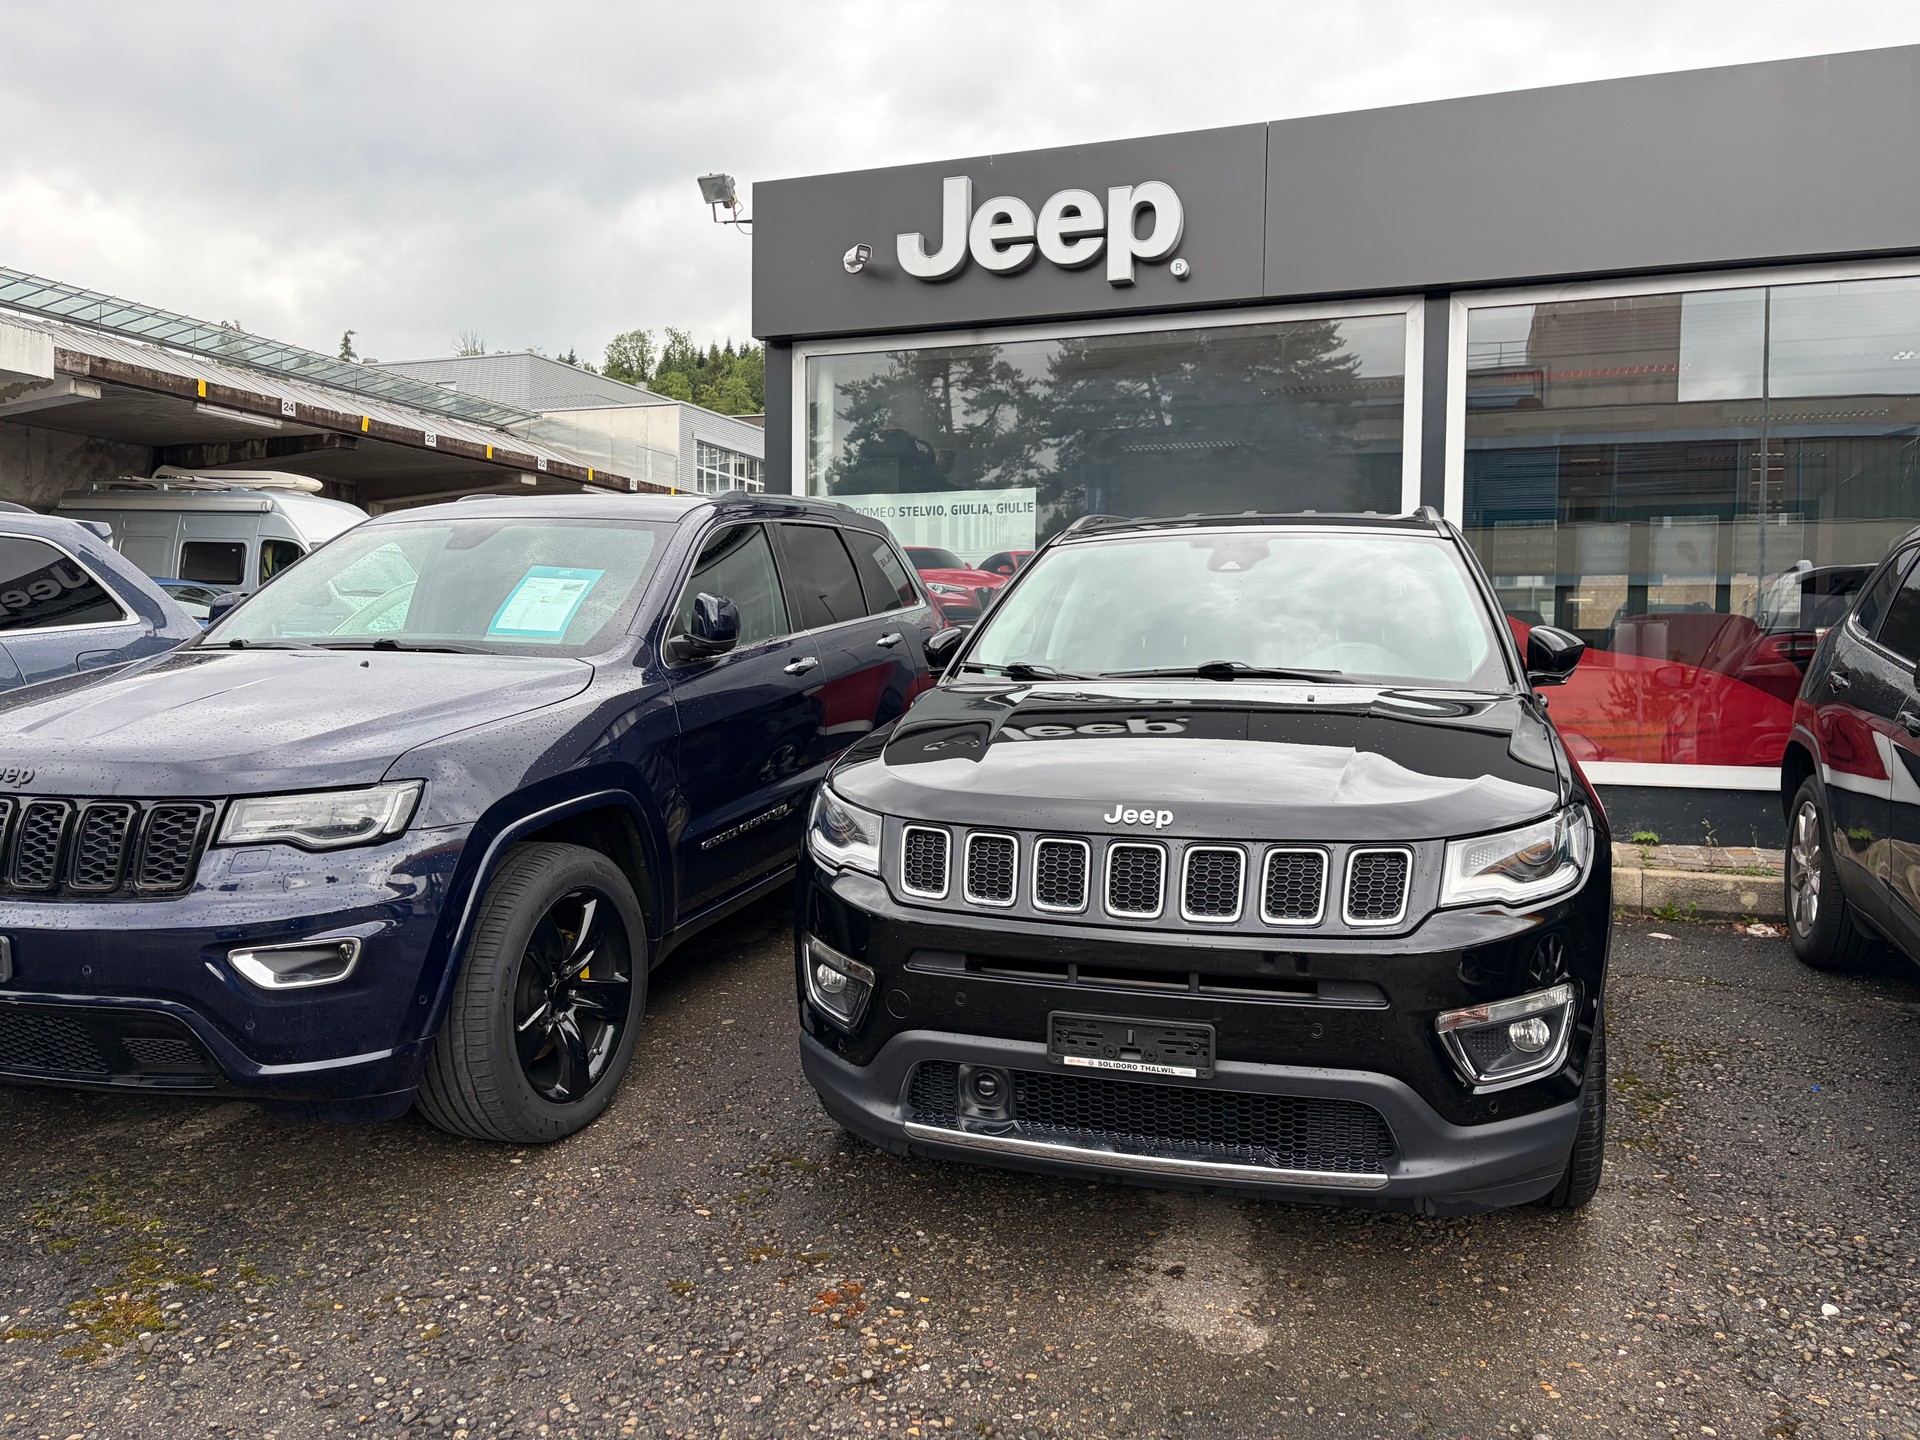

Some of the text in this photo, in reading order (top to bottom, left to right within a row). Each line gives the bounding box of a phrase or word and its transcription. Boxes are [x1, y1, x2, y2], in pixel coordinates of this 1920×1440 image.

[896, 175, 1185, 287] Jeep
[283, 403, 294, 413] 24
[426, 434, 435, 443] 23
[539, 459, 546, 468] 22
[631, 480, 637, 488] 21
[898, 505, 948, 517] STELVIO,
[951, 503, 993, 516] GIULIA,
[996, 501, 1034, 514] GIULIE
[1103, 804, 1174, 829] Jeep
[1097, 1060, 1138, 1070] SOLIDORO
[1140, 1064, 1176, 1074] THALWIL
